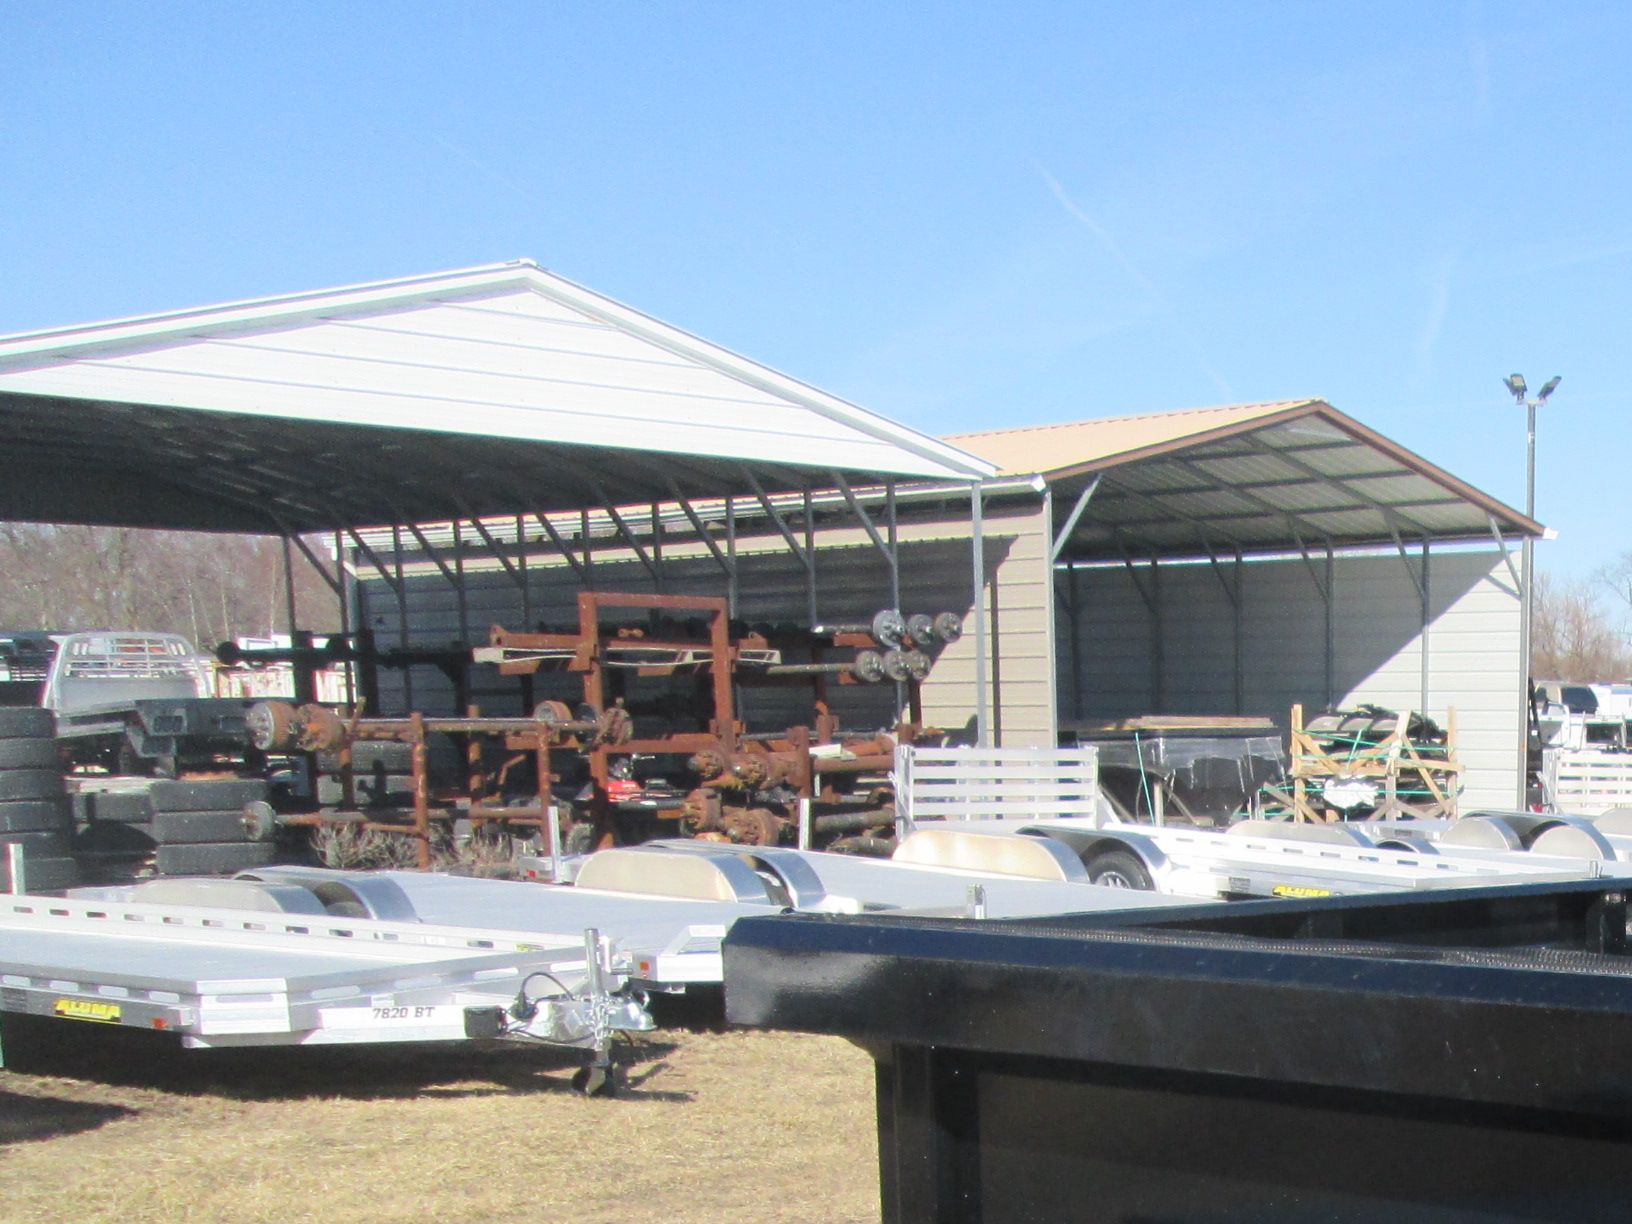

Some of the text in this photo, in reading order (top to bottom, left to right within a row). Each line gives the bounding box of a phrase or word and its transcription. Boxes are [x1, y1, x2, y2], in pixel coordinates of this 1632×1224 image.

[1273, 884, 1331, 898] ALUMA
[56, 999, 121, 1020] ALUMA
[372, 1006, 435, 1019] 7820 BT
